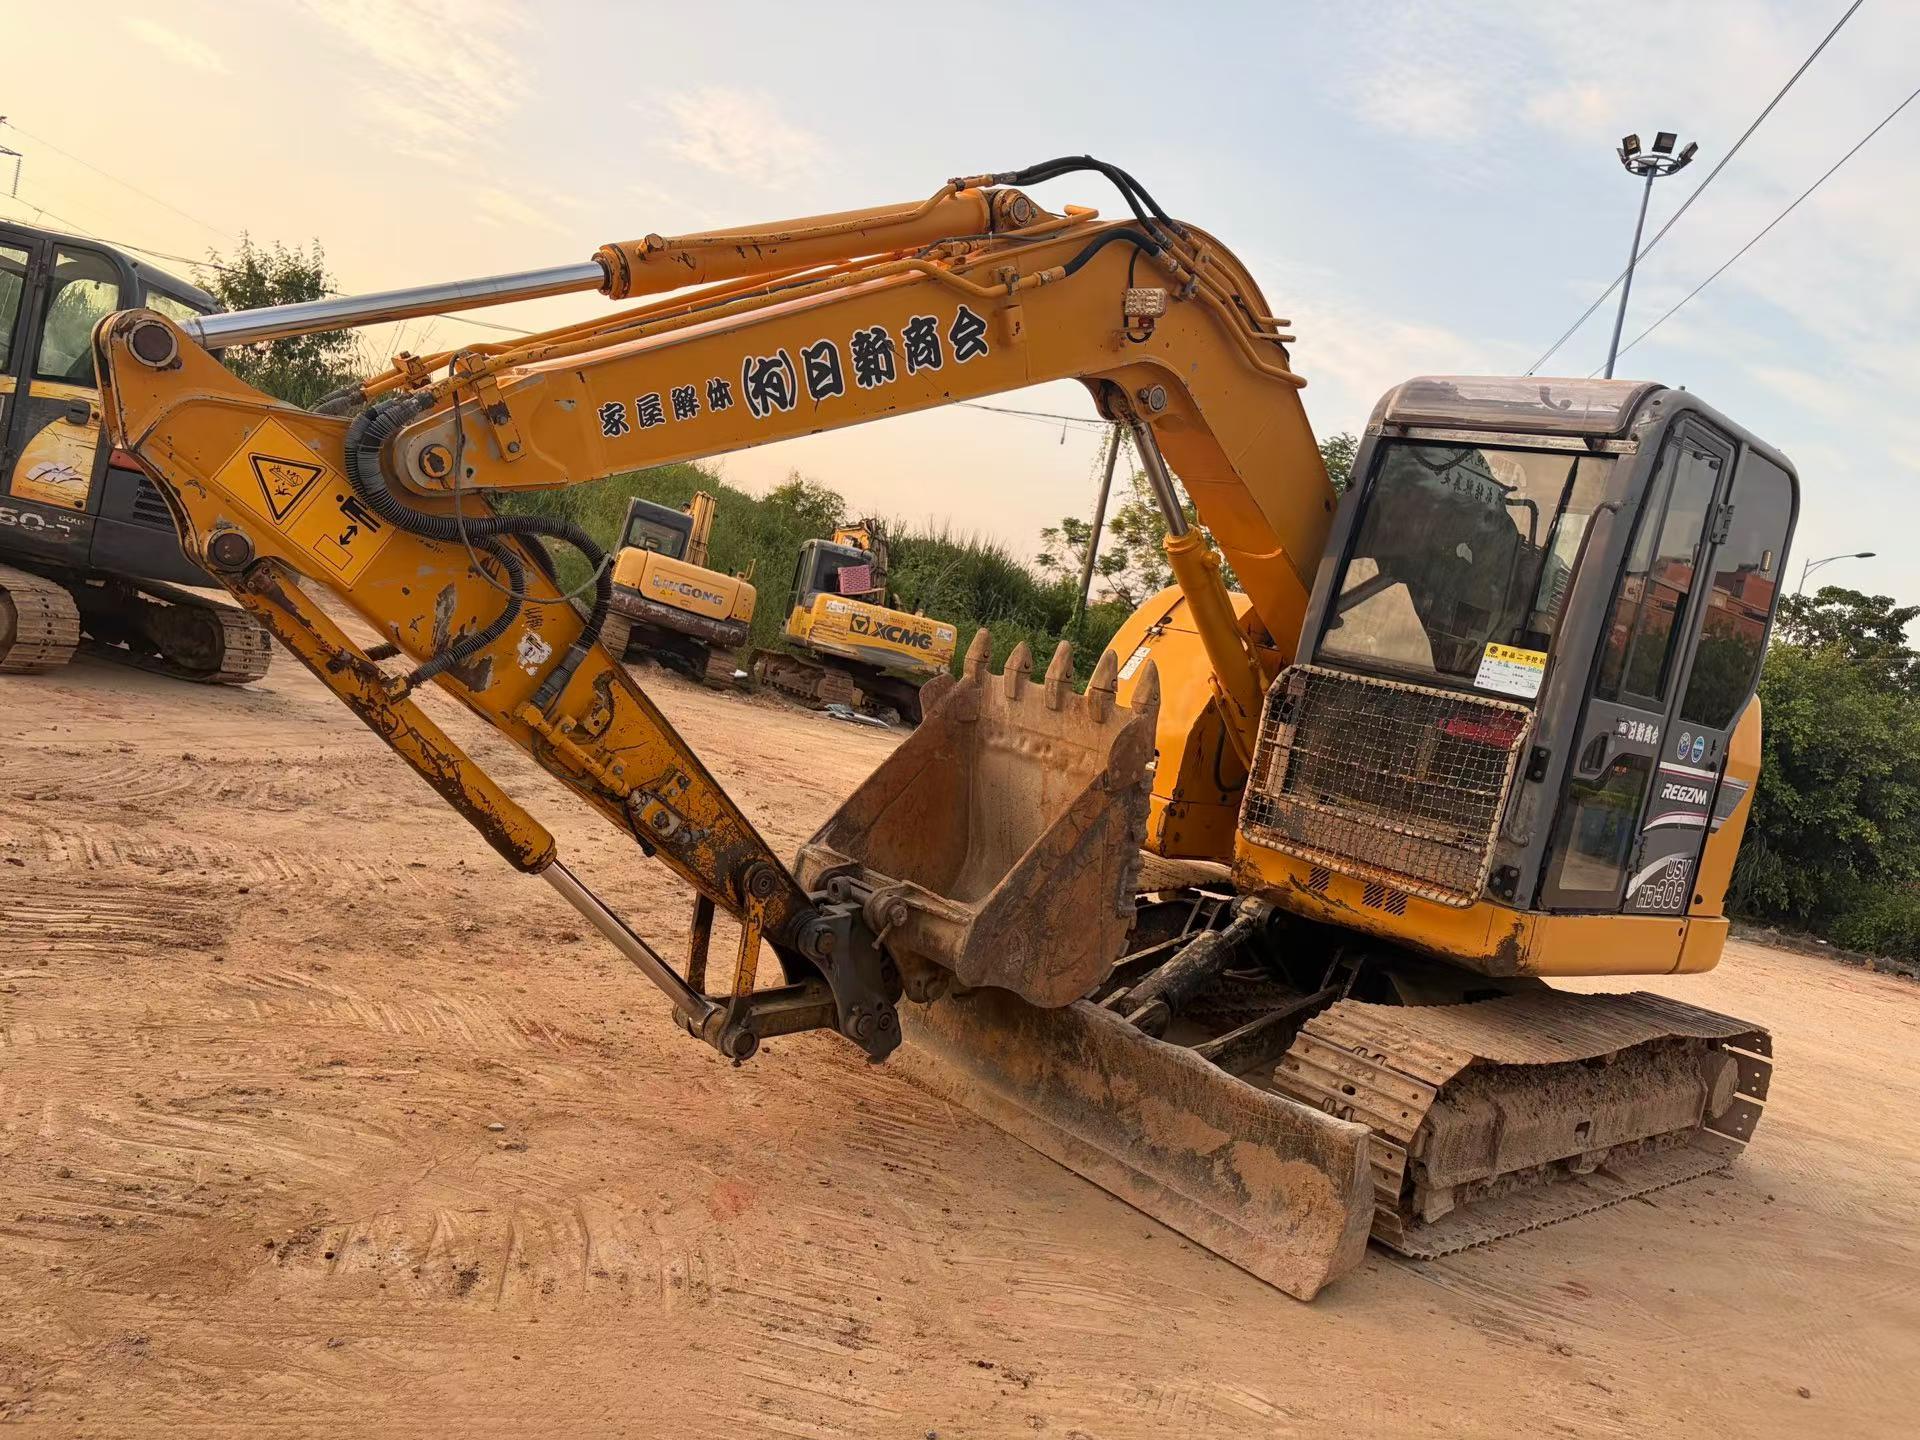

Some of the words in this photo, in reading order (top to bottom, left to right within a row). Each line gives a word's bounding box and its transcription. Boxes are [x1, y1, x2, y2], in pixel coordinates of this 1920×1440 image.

[868, 620, 933, 650] XCMG
[1666, 858, 1692, 880] USV
[1636, 879, 1685, 910] HD308
